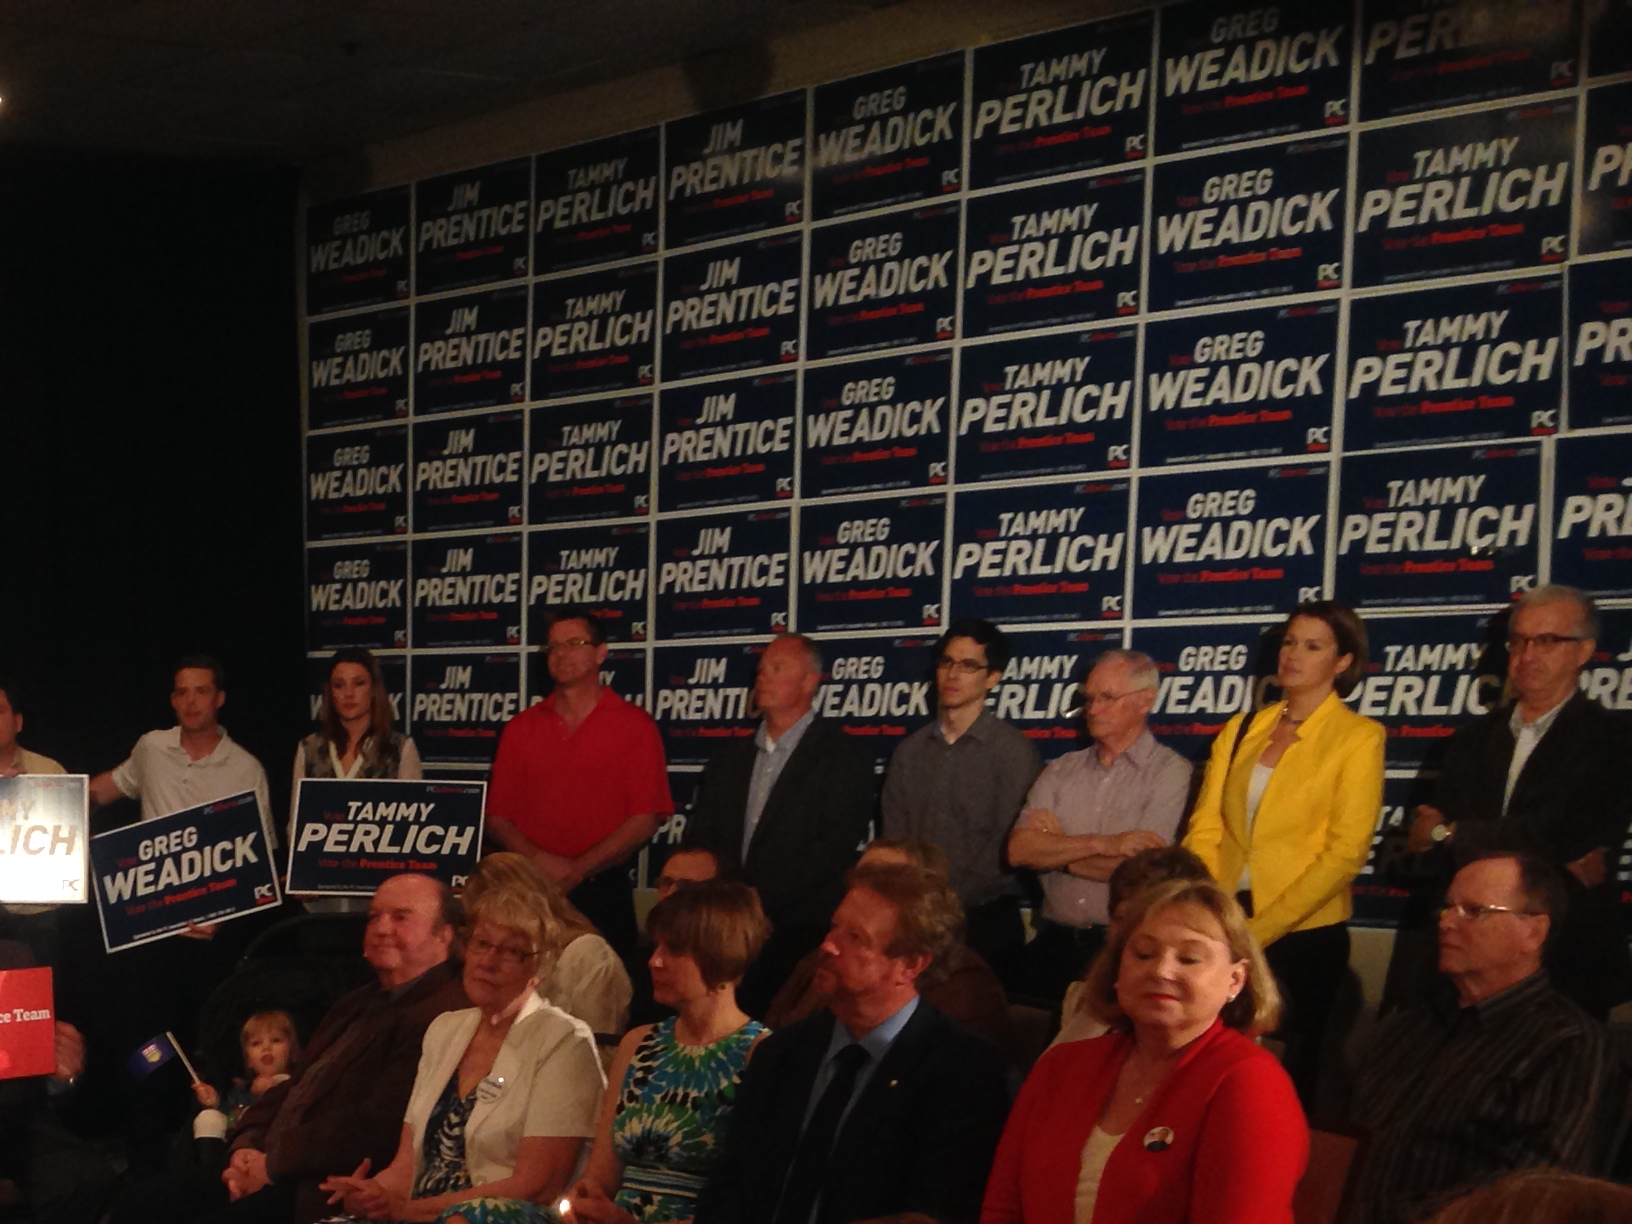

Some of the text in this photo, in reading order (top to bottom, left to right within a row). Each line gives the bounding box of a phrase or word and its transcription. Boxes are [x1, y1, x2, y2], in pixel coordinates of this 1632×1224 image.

[1209, 1, 1281, 45] GREG
[1020, 47, 1107, 89] TAMMY
[1163, 19, 1350, 101] WEADICK
[852, 85, 906, 120] GREG
[973, 68, 1147, 140] PERLICH
[702, 118, 743, 154] JIM
[815, 101, 957, 167] WEADICK
[568, 157, 627, 188] TAMMY
[668, 136, 802, 200] PRENTICE
[1413, 136, 1519, 179] TAMMY
[446, 181, 480, 211] JIM
[1202, 167, 1274, 204] GREG
[1356, 158, 1568, 236] PERLICH
[535, 175, 657, 233] PERLICH
[1011, 202, 1099, 241] TAMMY
[1157, 187, 1340, 255] WEADICK
[334, 211, 369, 236] GREG
[418, 199, 528, 252] PRENTICE
[310, 225, 405, 273] WEADICK
[848, 231, 903, 264] GREG
[965, 225, 1140, 289] PERLICH
[699, 256, 741, 291] JIM
[813, 249, 953, 309] WEADICK
[444, 305, 478, 335] JIM
[565, 289, 626, 319] TAMMY
[664, 277, 801, 335] PRENTICE
[334, 328, 371, 353] GREG
[533, 308, 654, 360] PERLICH
[1193, 330, 1265, 364] GREG
[1403, 310, 1509, 348] TAMMY
[312, 342, 405, 388] WEADICK
[416, 326, 525, 373] PRENTICE
[1347, 336, 1559, 399] PERLICH
[840, 375, 895, 406] GREG
[1004, 356, 1091, 391] TAMMY
[1148, 352, 1331, 411] WEADICK
[694, 392, 736, 425] JIM
[807, 396, 946, 449] WEADICK
[959, 379, 1132, 436] PERLICH
[442, 428, 475, 455] JIM
[562, 419, 622, 447] TAMMY
[661, 415, 794, 466] PRENTICE
[332, 443, 370, 467] GREG
[415, 449, 522, 492] PRENTICE
[529, 440, 650, 484] PERLICH
[310, 460, 404, 501] WEADICK
[1387, 474, 1486, 508] TAMMY
[998, 505, 1083, 537] TAMMY
[1185, 488, 1256, 519] GREG
[690, 526, 732, 556] JIM
[836, 517, 891, 545] GREG
[1141, 514, 1321, 565] WEADICK
[1335, 502, 1536, 558] PERLICH
[332, 558, 370, 579] GREG
[440, 547, 474, 573] JIM
[559, 546, 619, 570] TAMMY
[658, 552, 789, 594] PRENTICE
[802, 539, 940, 584] WEADICK
[953, 531, 1125, 579] PERLICH
[310, 578, 404, 611] WEADICK
[413, 572, 520, 607] PRENTICE
[527, 568, 647, 606] PERLICH
[687, 657, 727, 685] JIM
[831, 655, 885, 679] GREG
[1002, 654, 1079, 681] AMMY
[1176, 642, 1248, 672] GREG
[1383, 642, 1486, 672] TAMMY
[439, 665, 472, 690] JIM
[412, 692, 518, 722] PRENTICE
[346, 801, 436, 823] TAMMY
[137, 825, 199, 861] GREG
[296, 822, 476, 856] PERLICH
[101, 830, 259, 906] WEADICK
[253, 883, 274, 899] PC
[13, 1007, 51, 1022] Team
